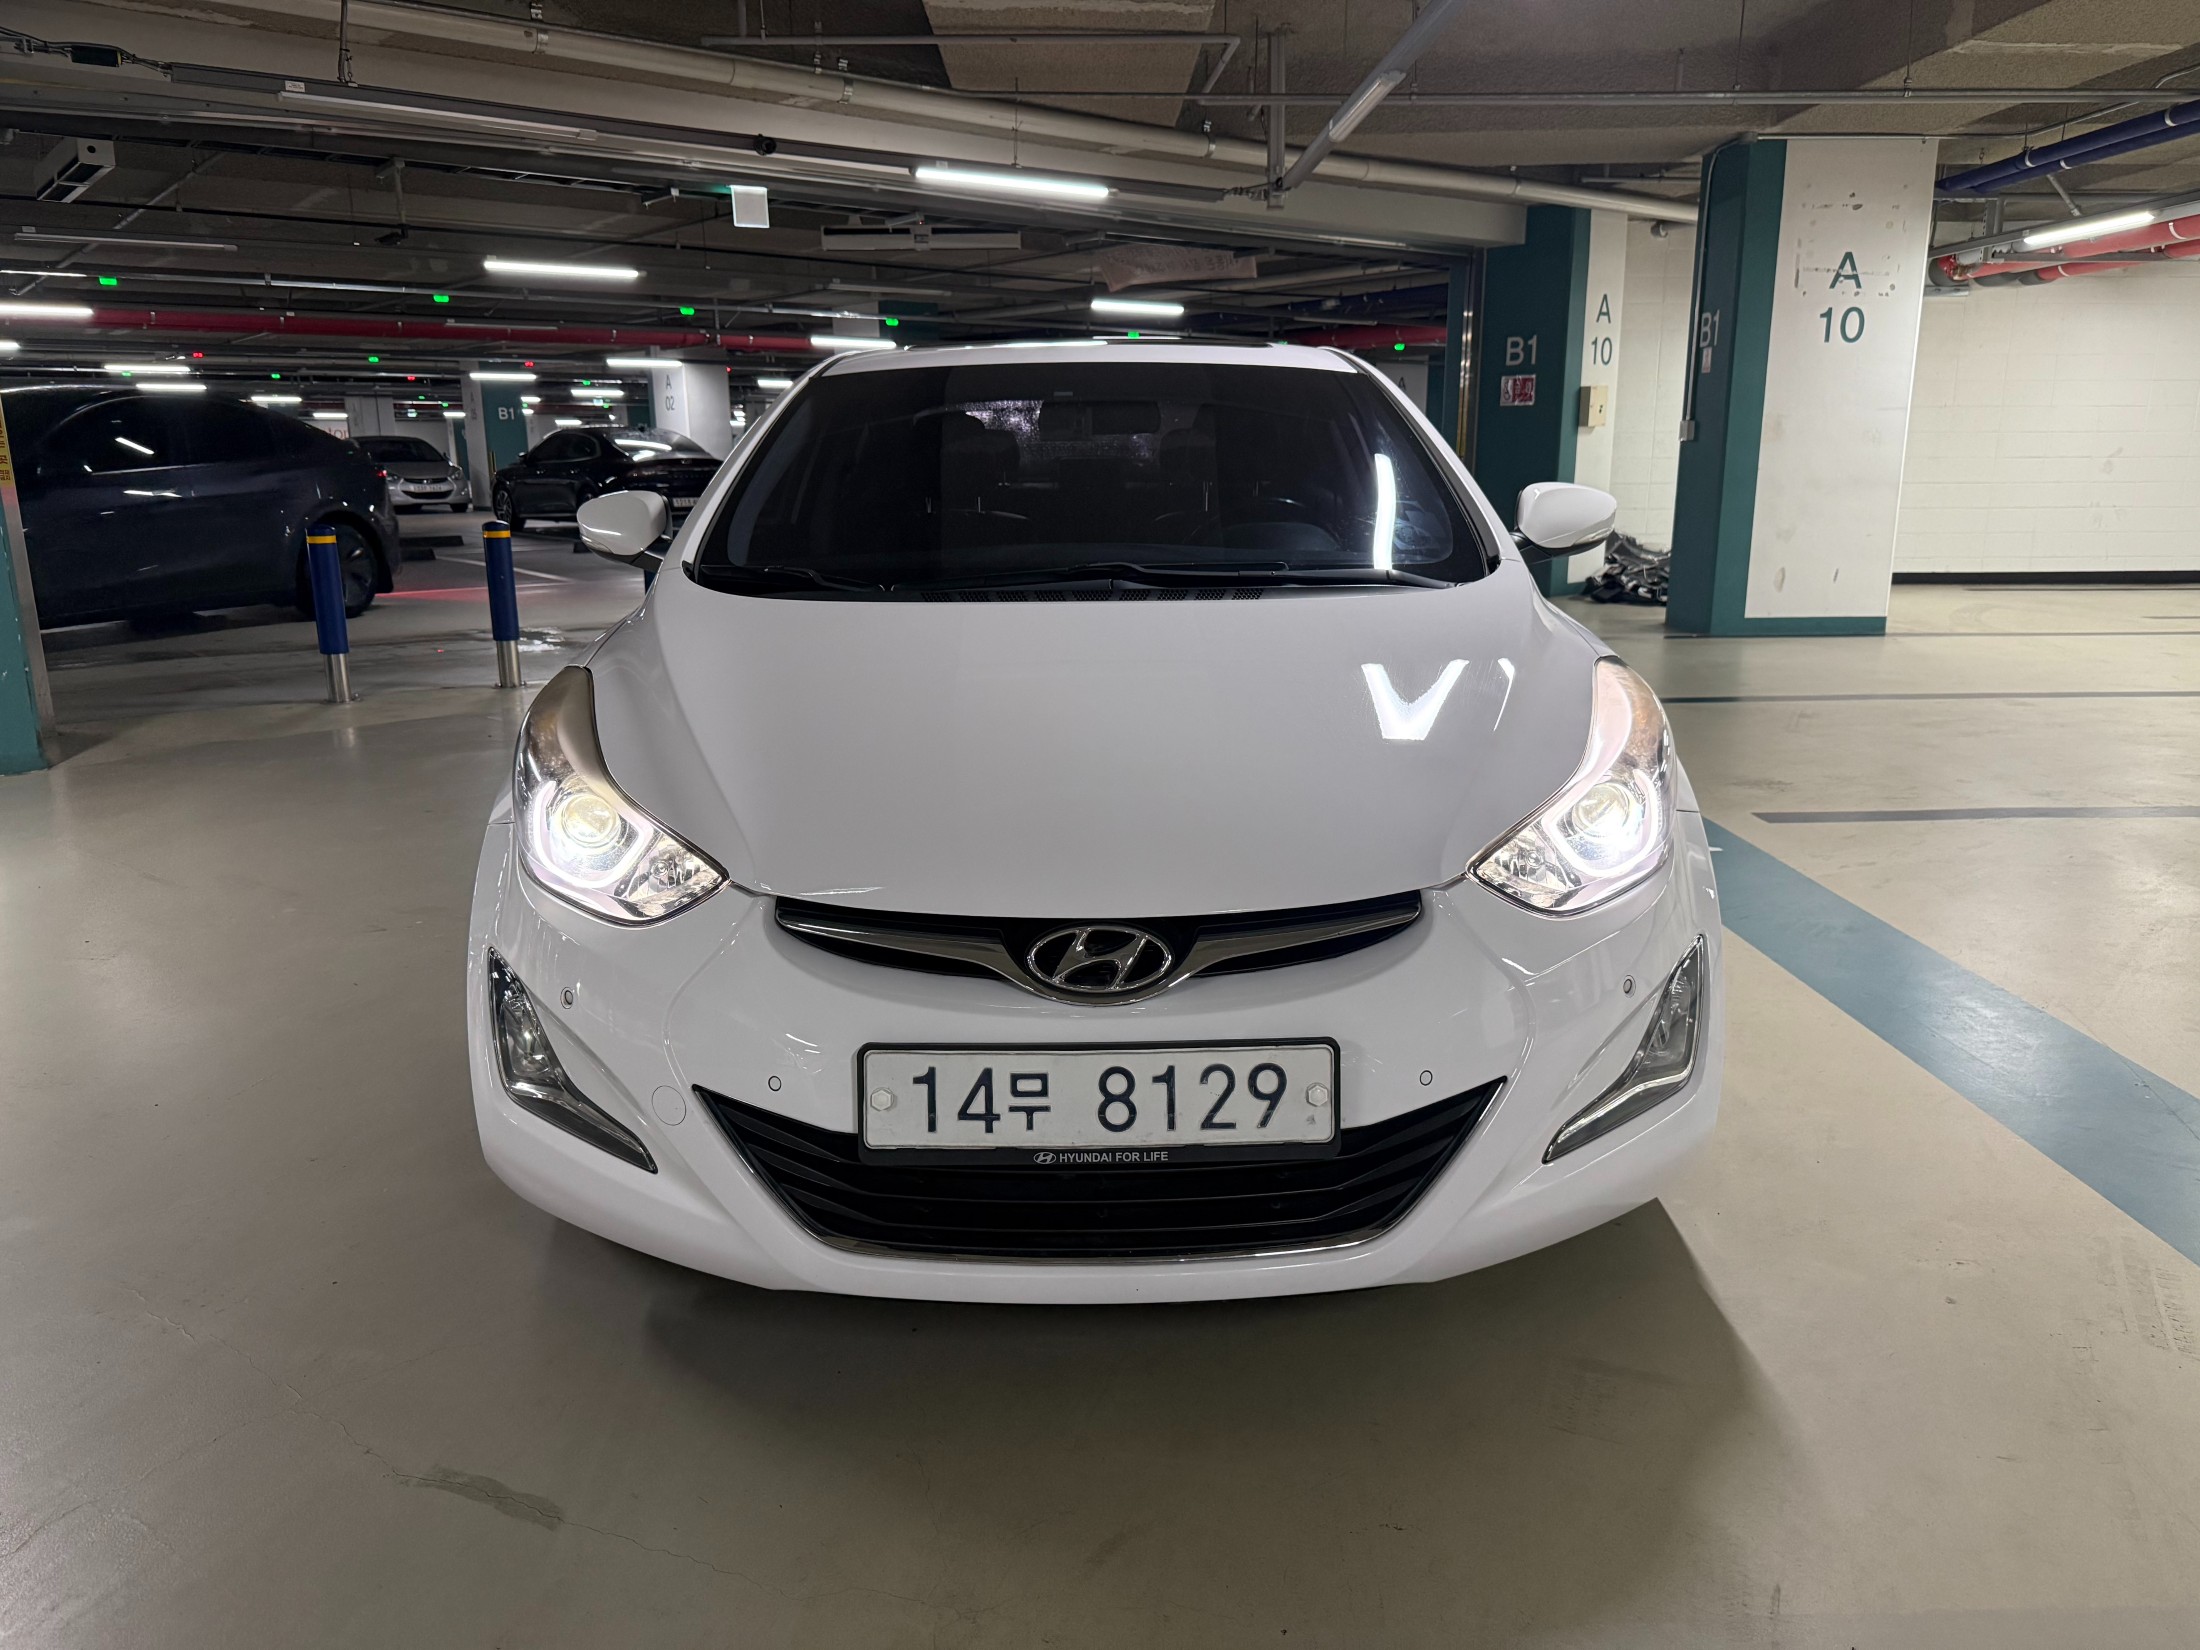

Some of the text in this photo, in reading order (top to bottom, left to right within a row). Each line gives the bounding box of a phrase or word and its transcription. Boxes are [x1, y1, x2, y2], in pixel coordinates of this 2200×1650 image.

[1828, 251, 1862, 290] A
[1596, 294, 1611, 324] A
[1699, 309, 1720, 348] B1
[1819, 306, 1865, 344] 10
[1505, 334, 1538, 367] B1
[1591, 336, 1613, 366] 10
[665, 374, 673, 390] A
[498, 407, 515, 420] B1
[665, 395, 676, 412] 02
[911, 1062, 1288, 1134] 14무 8129
[1059, 1151, 1169, 1163] HYUNDAI FOR LIFE
